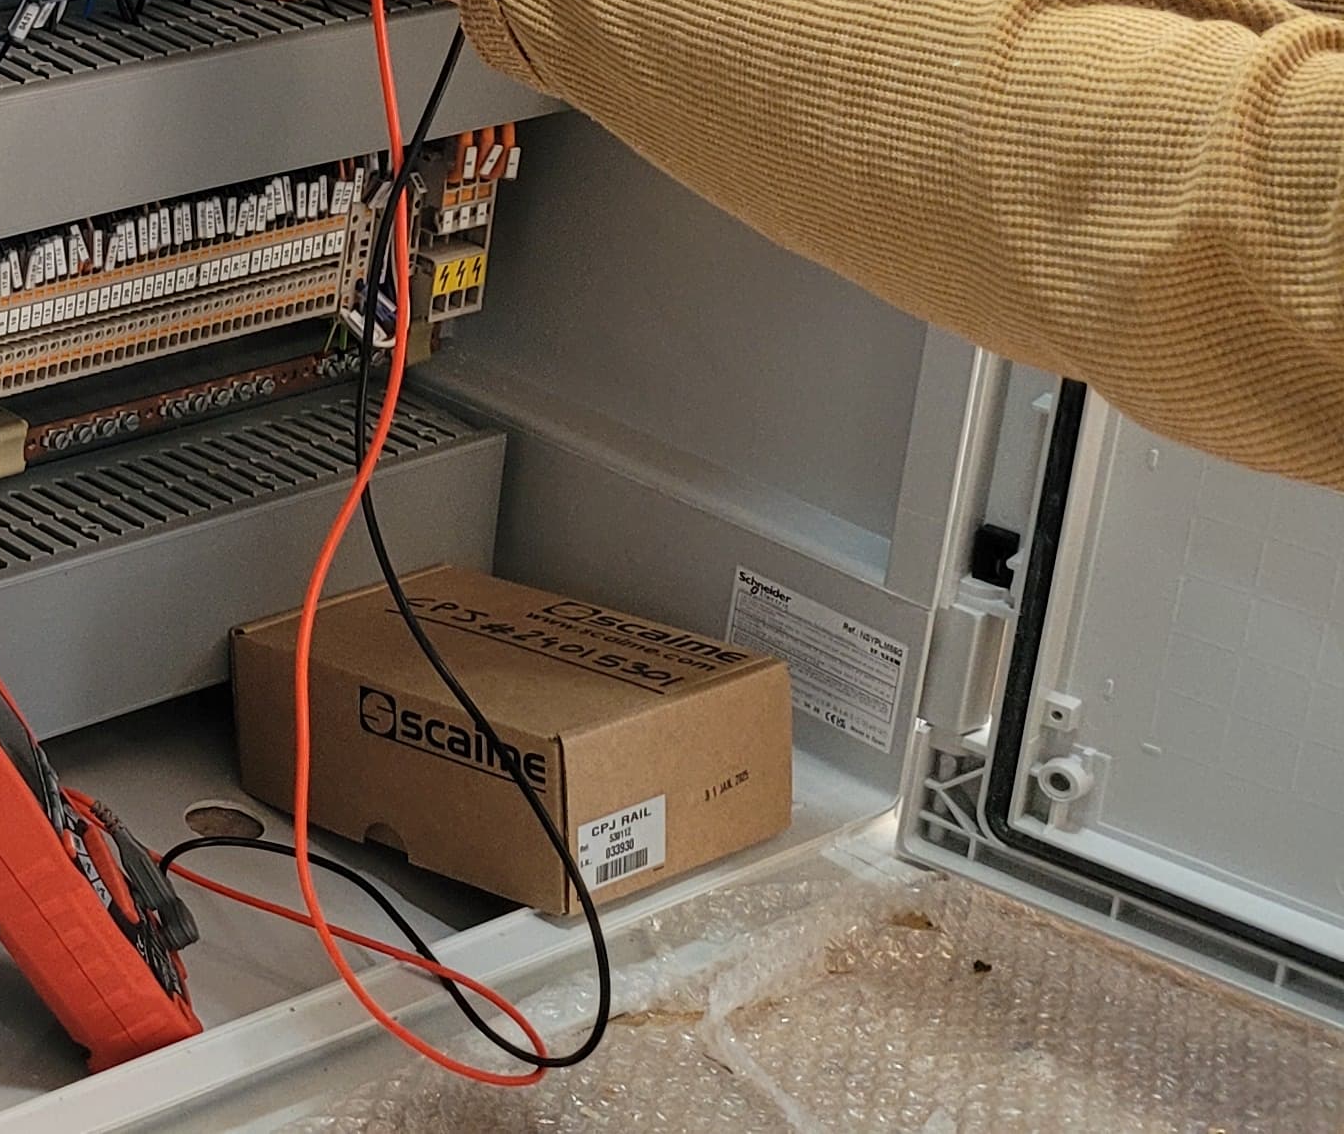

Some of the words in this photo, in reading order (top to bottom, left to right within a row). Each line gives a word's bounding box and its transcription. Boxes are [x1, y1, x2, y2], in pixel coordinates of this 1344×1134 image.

[738, 571, 792, 603] Schneider
[527, 612, 716, 672] www.scaime.com
[589, 616, 749, 664] scaime
[591, 822, 617, 837] CPJ
[621, 807, 652, 826] RAIL
[605, 838, 635, 859] 033930
